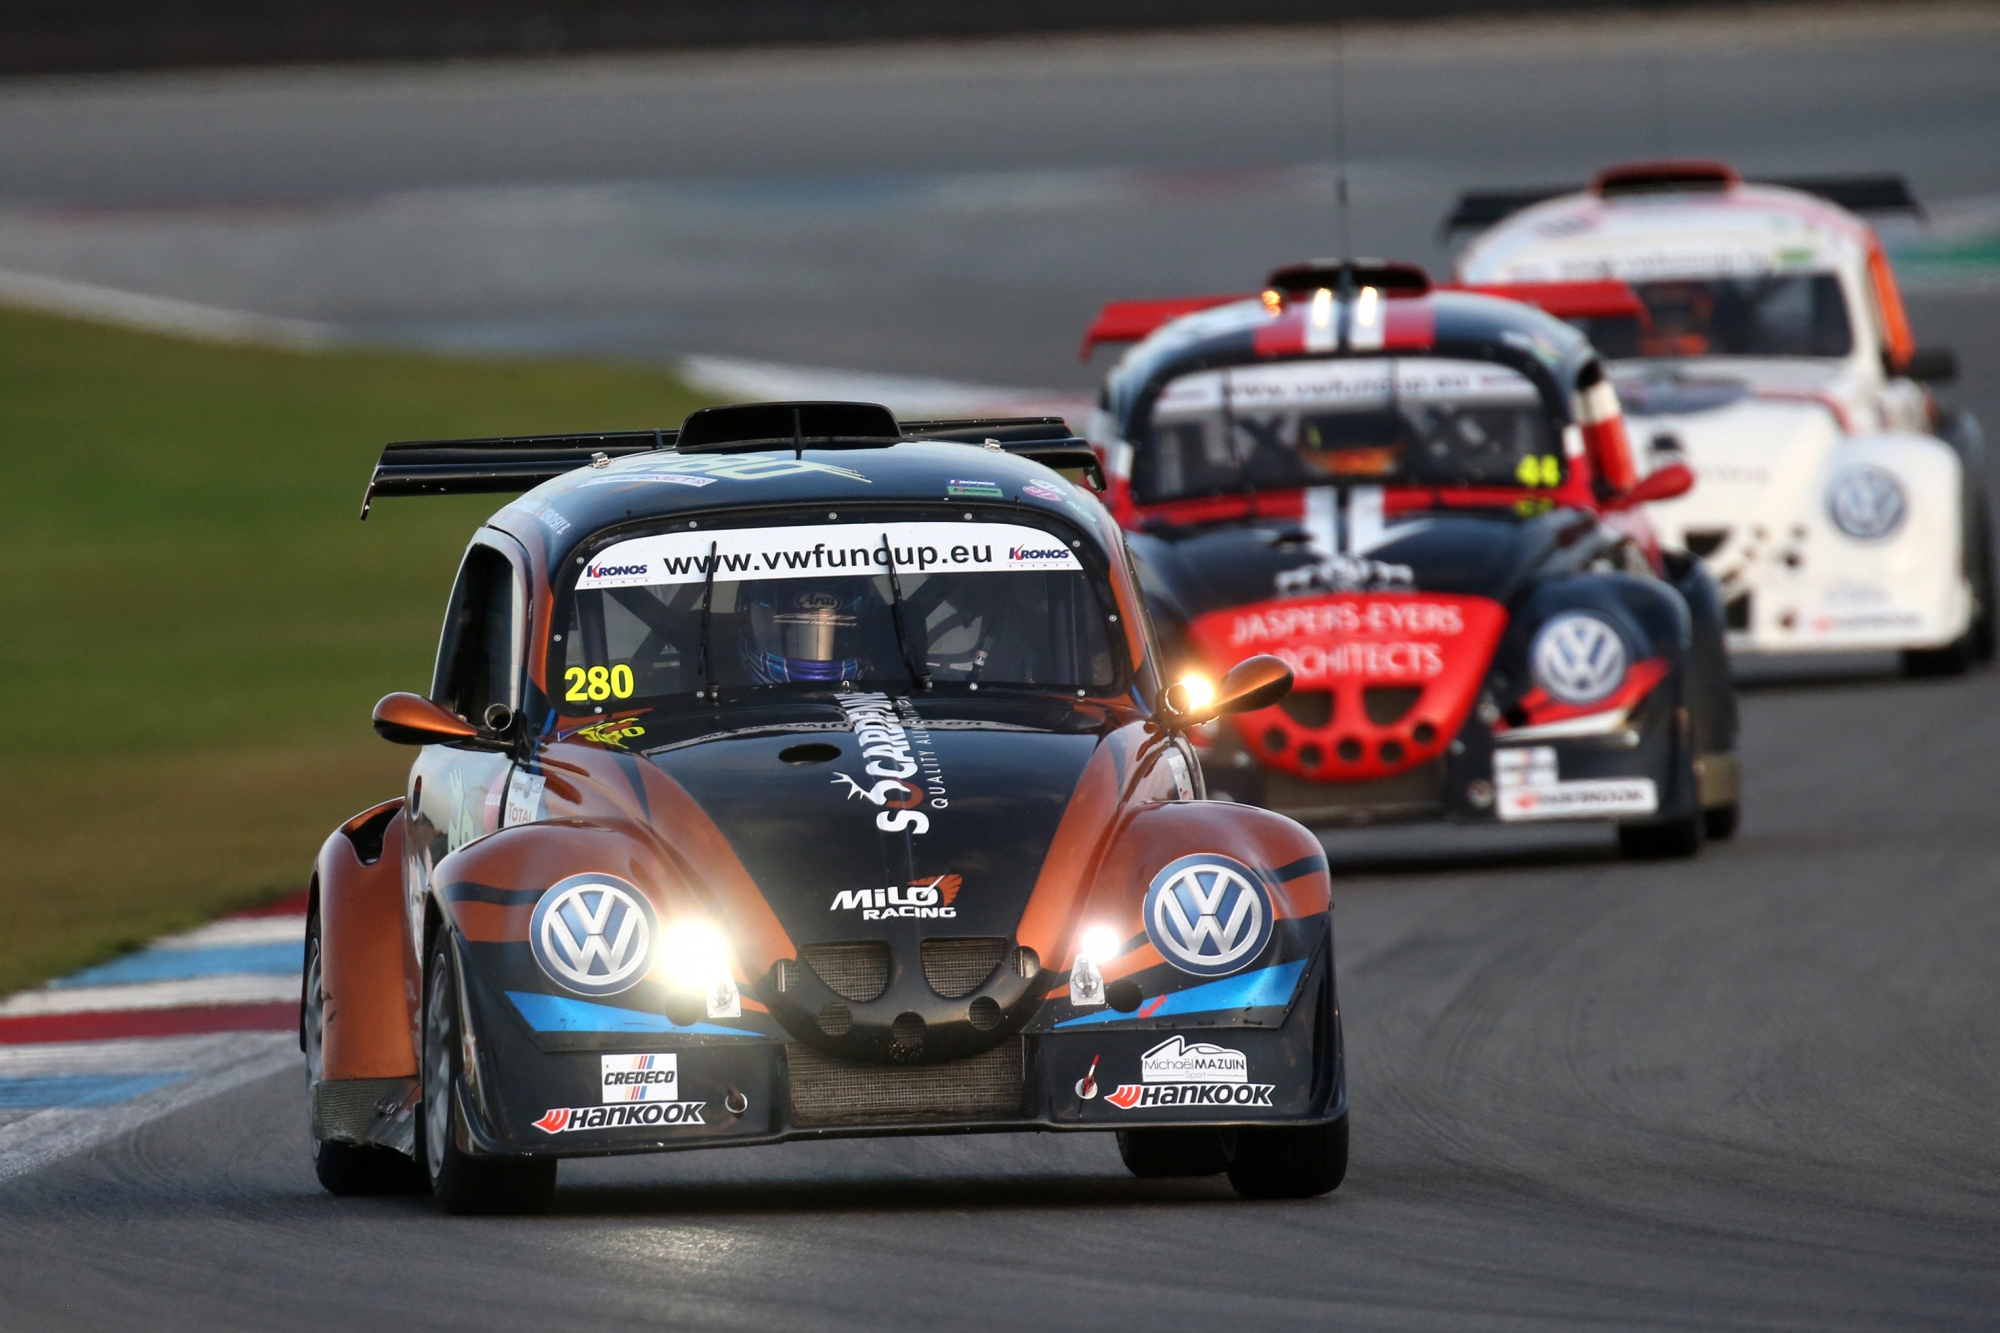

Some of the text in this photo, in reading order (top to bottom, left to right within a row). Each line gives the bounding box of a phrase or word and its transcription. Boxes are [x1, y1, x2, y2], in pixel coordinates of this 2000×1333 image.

[1516, 453, 1560, 489] 44
[663, 543, 993, 576] www.vwfuncup.eu
[1008, 543, 1070, 560] KRONOS
[586, 561, 648, 578] KRONOS
[564, 664, 634, 702] 280
[919, 750, 949, 809] QUALITY
[863, 906, 957, 920] RACING
[604, 1070, 676, 1086] CREDECO
